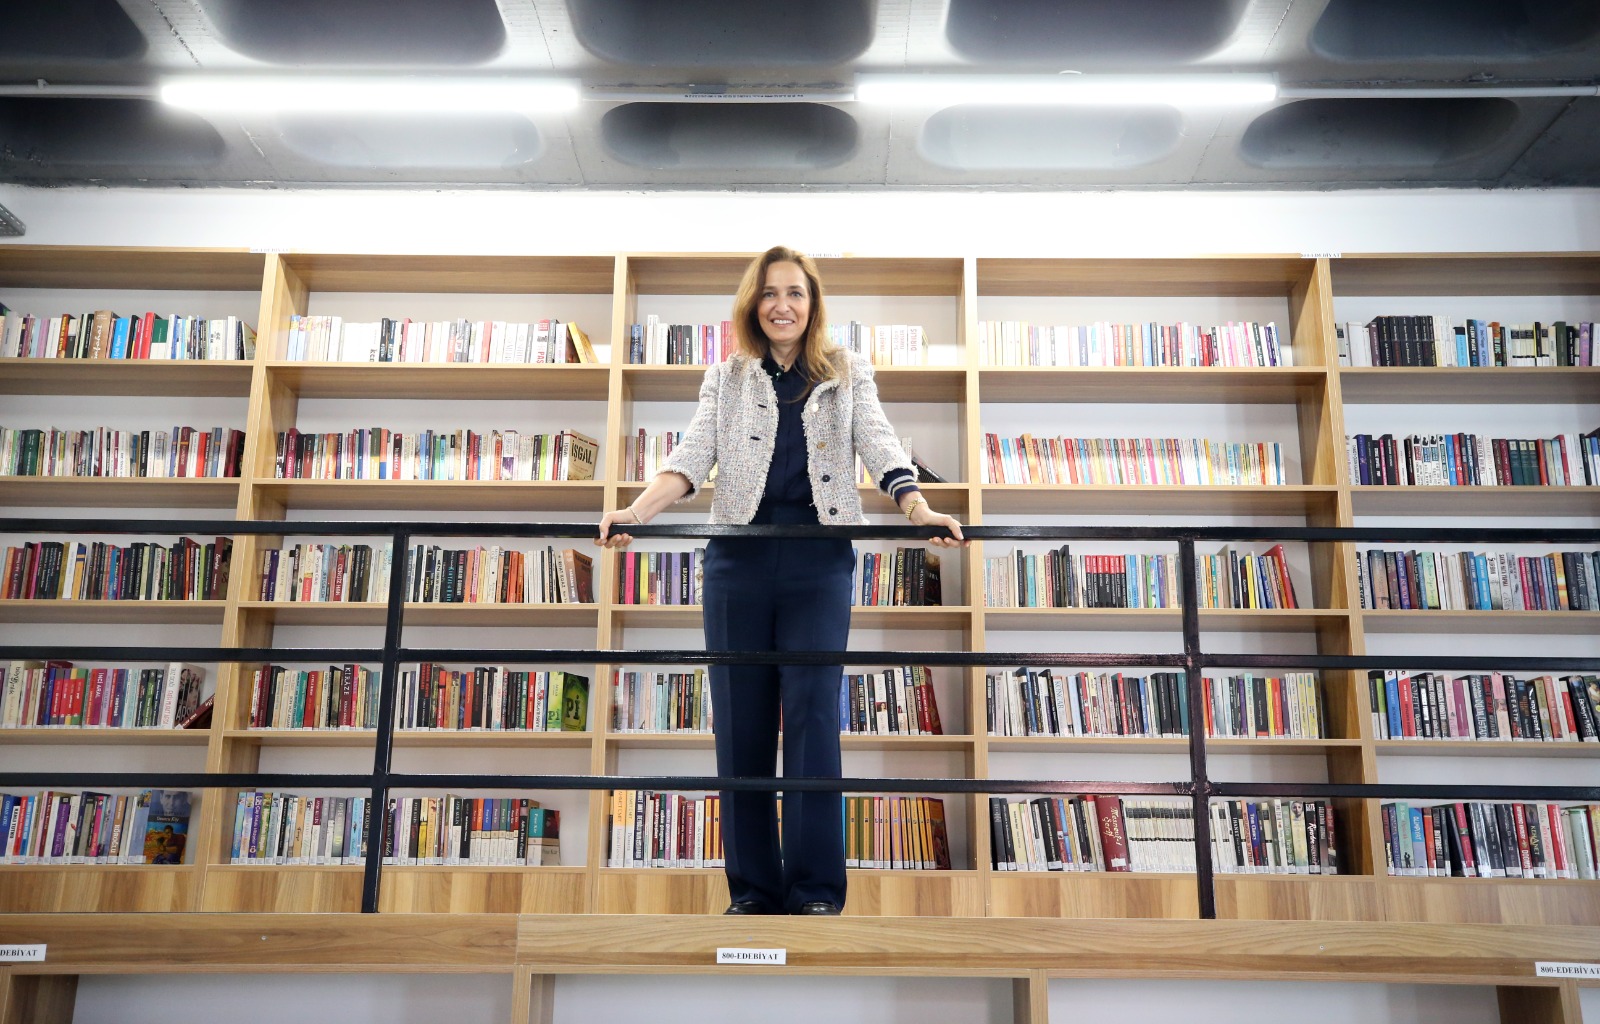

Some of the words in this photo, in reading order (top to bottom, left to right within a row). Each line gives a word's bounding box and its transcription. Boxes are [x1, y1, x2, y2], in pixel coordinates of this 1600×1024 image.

[571, 438, 592, 466] İŞGAL
[1054, 680, 1064, 710] KONGAR
[1507, 676, 1517, 698] AFTER
[1510, 699, 1518, 722] EARTH
[1578, 698, 1588, 719] Boleyn
[110, 824, 121, 854] KÖROĞLU
[721, 952, 779, 960] 800-EDEBİYAT
